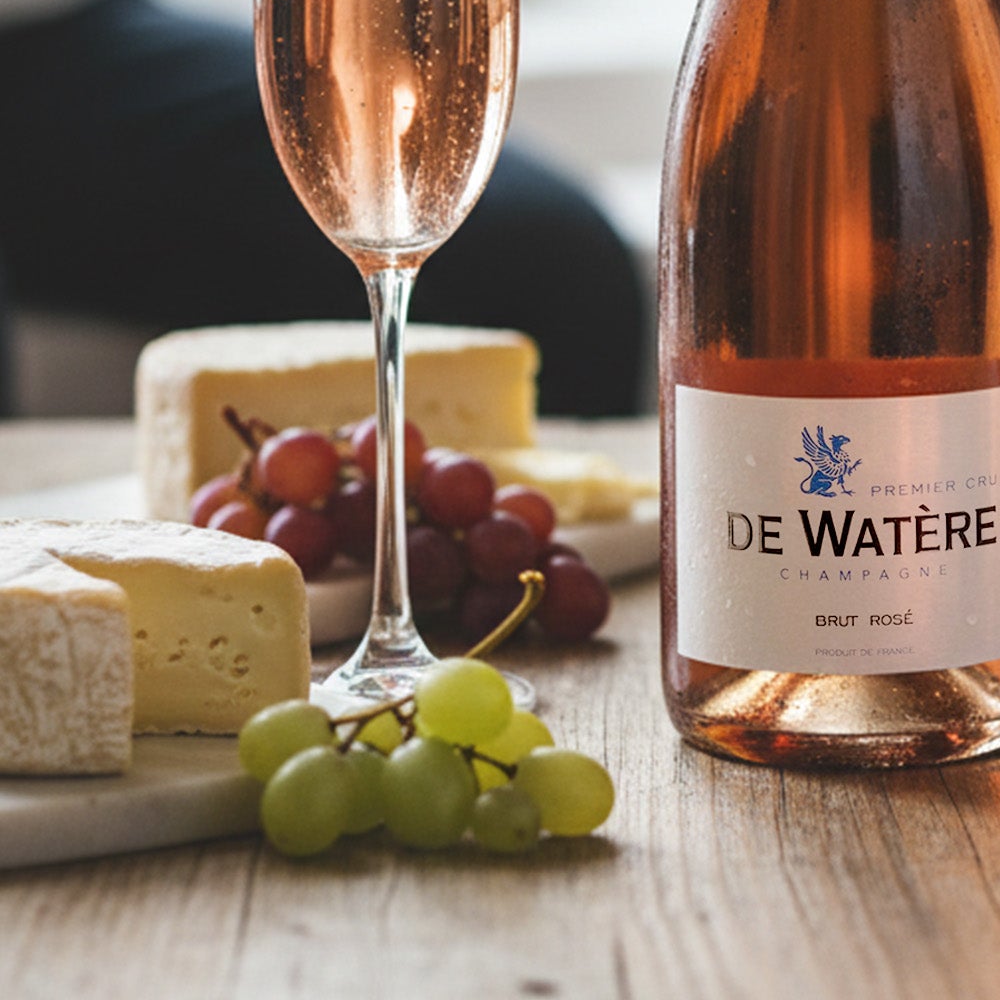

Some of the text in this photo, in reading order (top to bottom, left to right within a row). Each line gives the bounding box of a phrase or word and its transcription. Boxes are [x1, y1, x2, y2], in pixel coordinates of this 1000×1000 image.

[870, 475, 998, 497] PREMIER CRU
[727, 503, 998, 558] DE WATÈRE
[779, 564, 948, 582] CHAMPAGNE
[815, 608, 914, 628] BRUT ROSÉ
[815, 646, 916, 657] PRODUIT DE FRANCE
